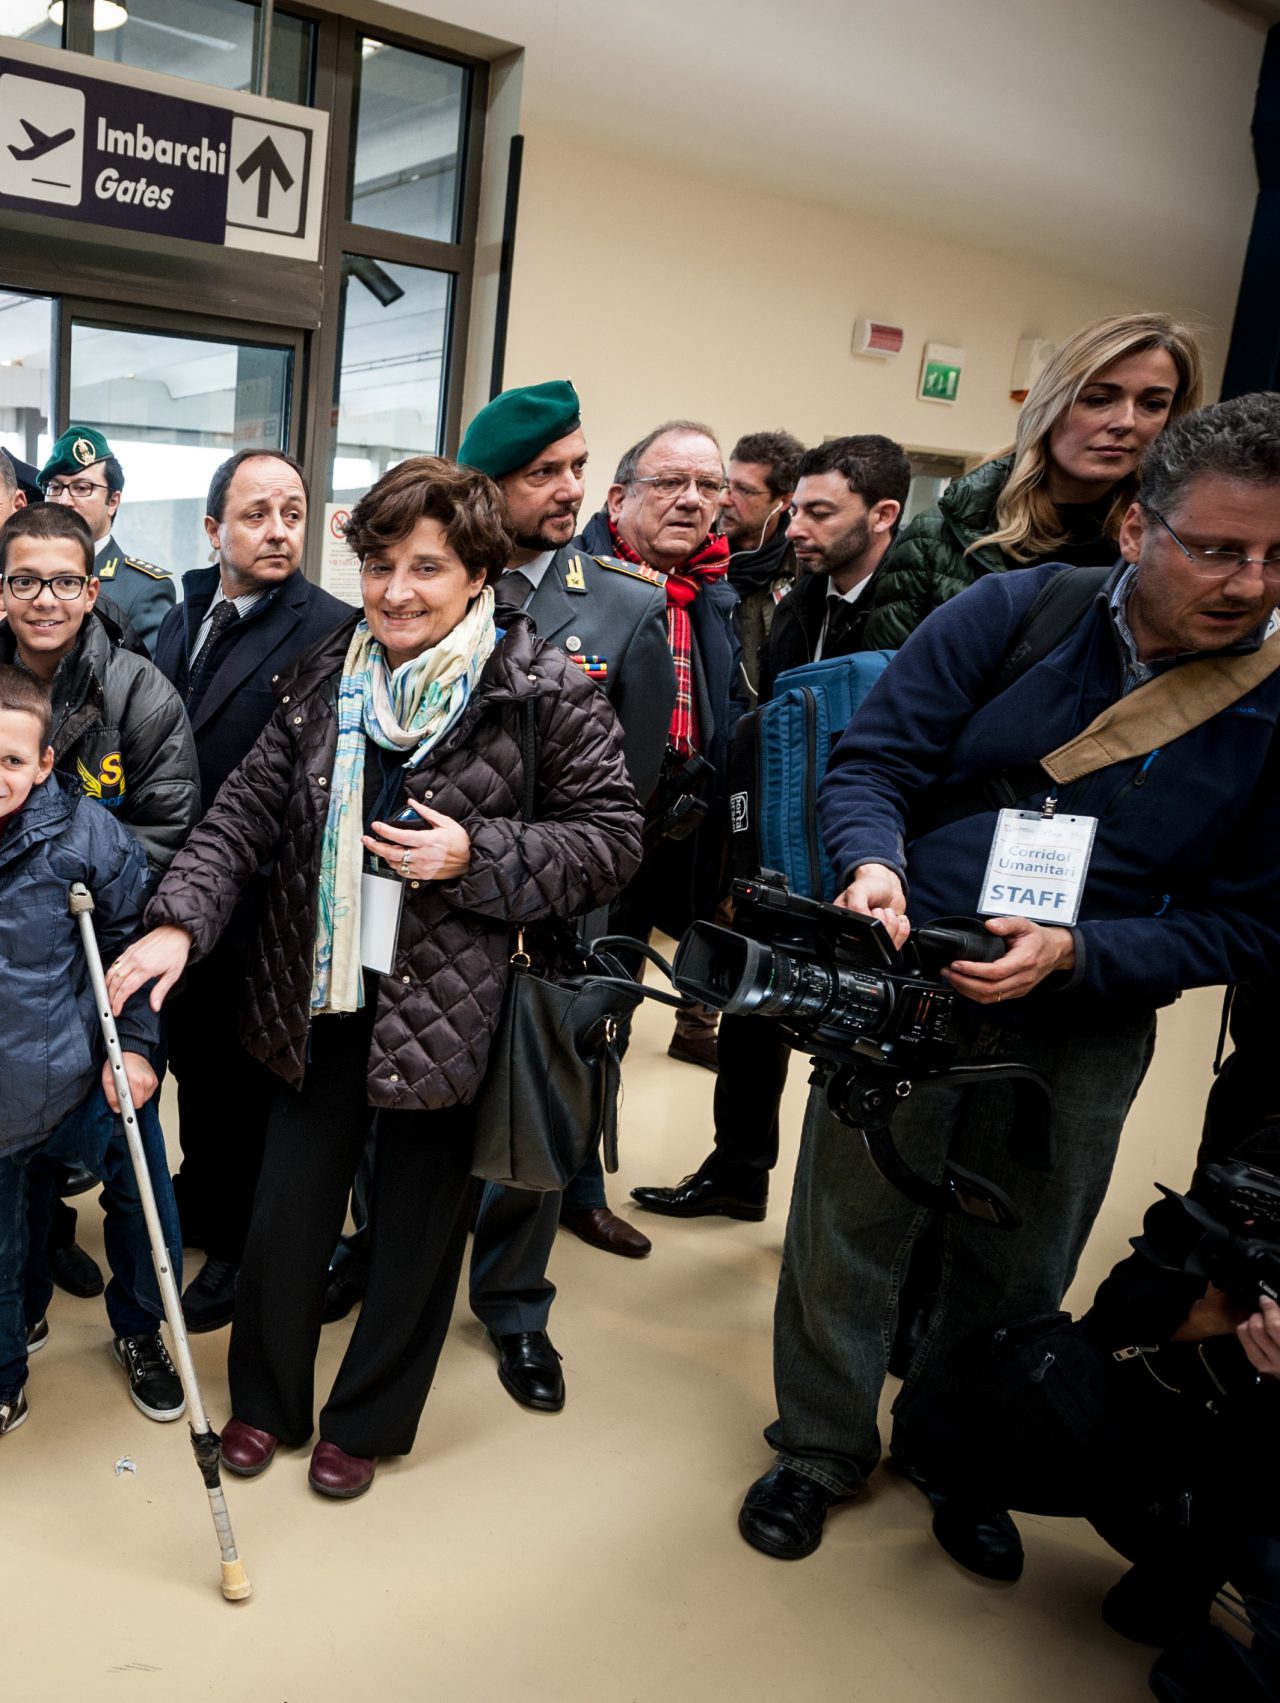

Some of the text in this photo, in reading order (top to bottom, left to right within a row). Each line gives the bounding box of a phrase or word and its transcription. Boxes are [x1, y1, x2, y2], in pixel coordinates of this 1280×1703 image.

[97, 116, 227, 175] Imbarchi
[94, 167, 174, 210] Gates
[999, 857, 1076, 876] Umanitari
[1008, 845, 1071, 863] Corridoi
[990, 884, 1069, 909] STAFF
